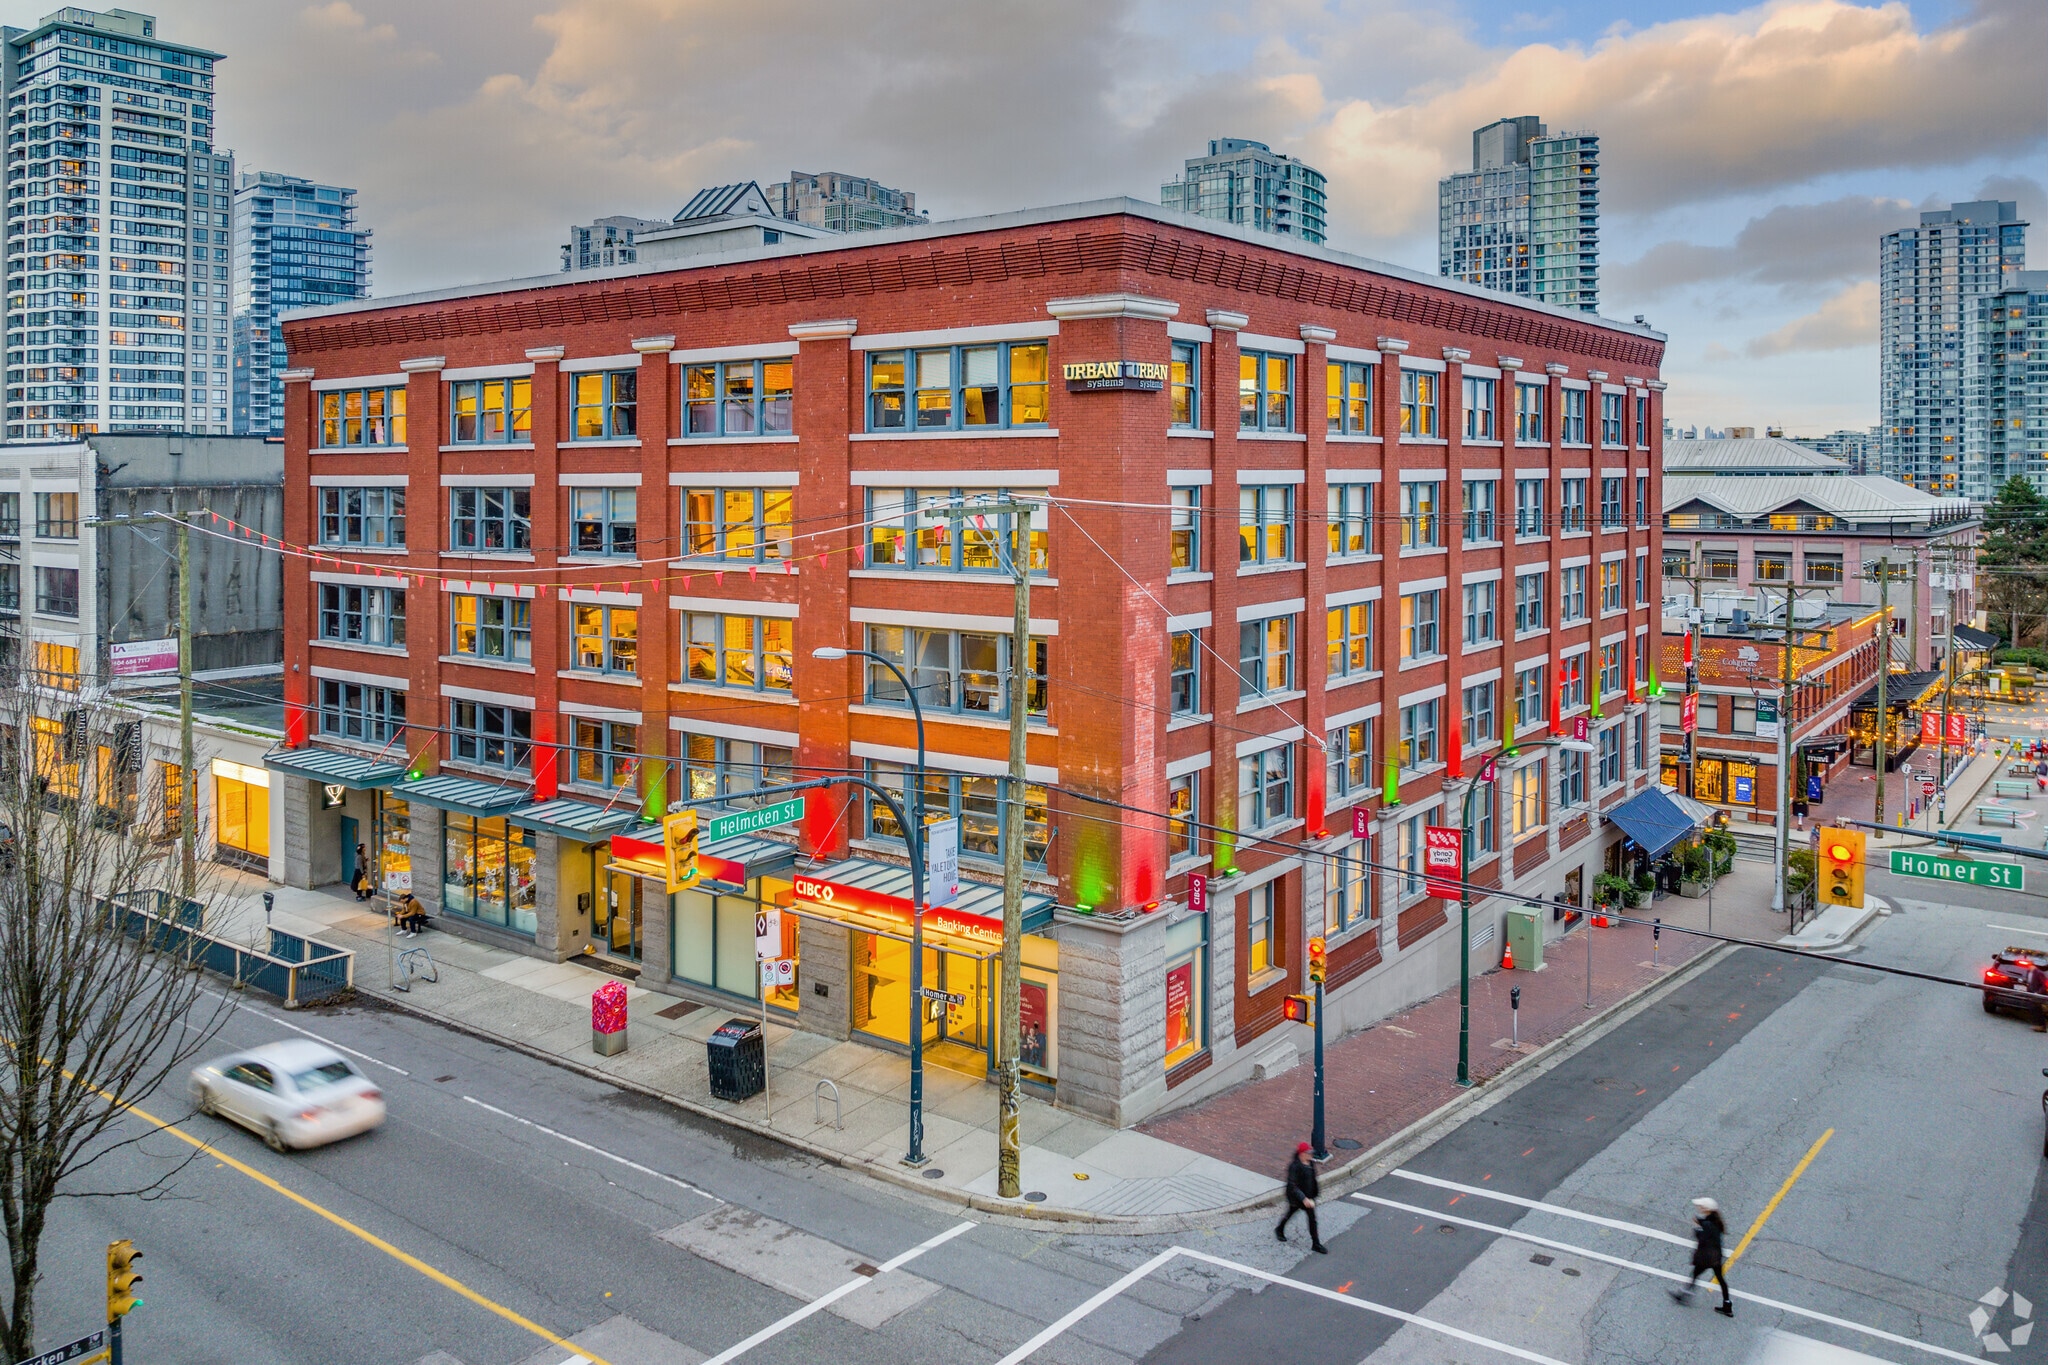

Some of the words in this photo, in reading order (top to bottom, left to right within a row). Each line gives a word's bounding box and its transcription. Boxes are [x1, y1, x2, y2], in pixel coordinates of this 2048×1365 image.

[1062, 361, 1121, 380] URBAN
[1131, 362, 1168, 380] URBAN
[1087, 379, 1123, 388] systems
[1140, 380, 1163, 389] systems
[1722, 658, 1757, 668] Columbus
[720, 810, 779, 836] Helmcken
[784, 803, 795, 819] St
[1902, 856, 1978, 881] Homer
[1990, 866, 2011, 885] St
[796, 880, 822, 899] CIBC
[1193, 886, 1201, 905] CIBC
[937, 916, 971, 936] Banking
[972, 924, 1002, 940] Centre
[925, 988, 948, 1001] Homer
